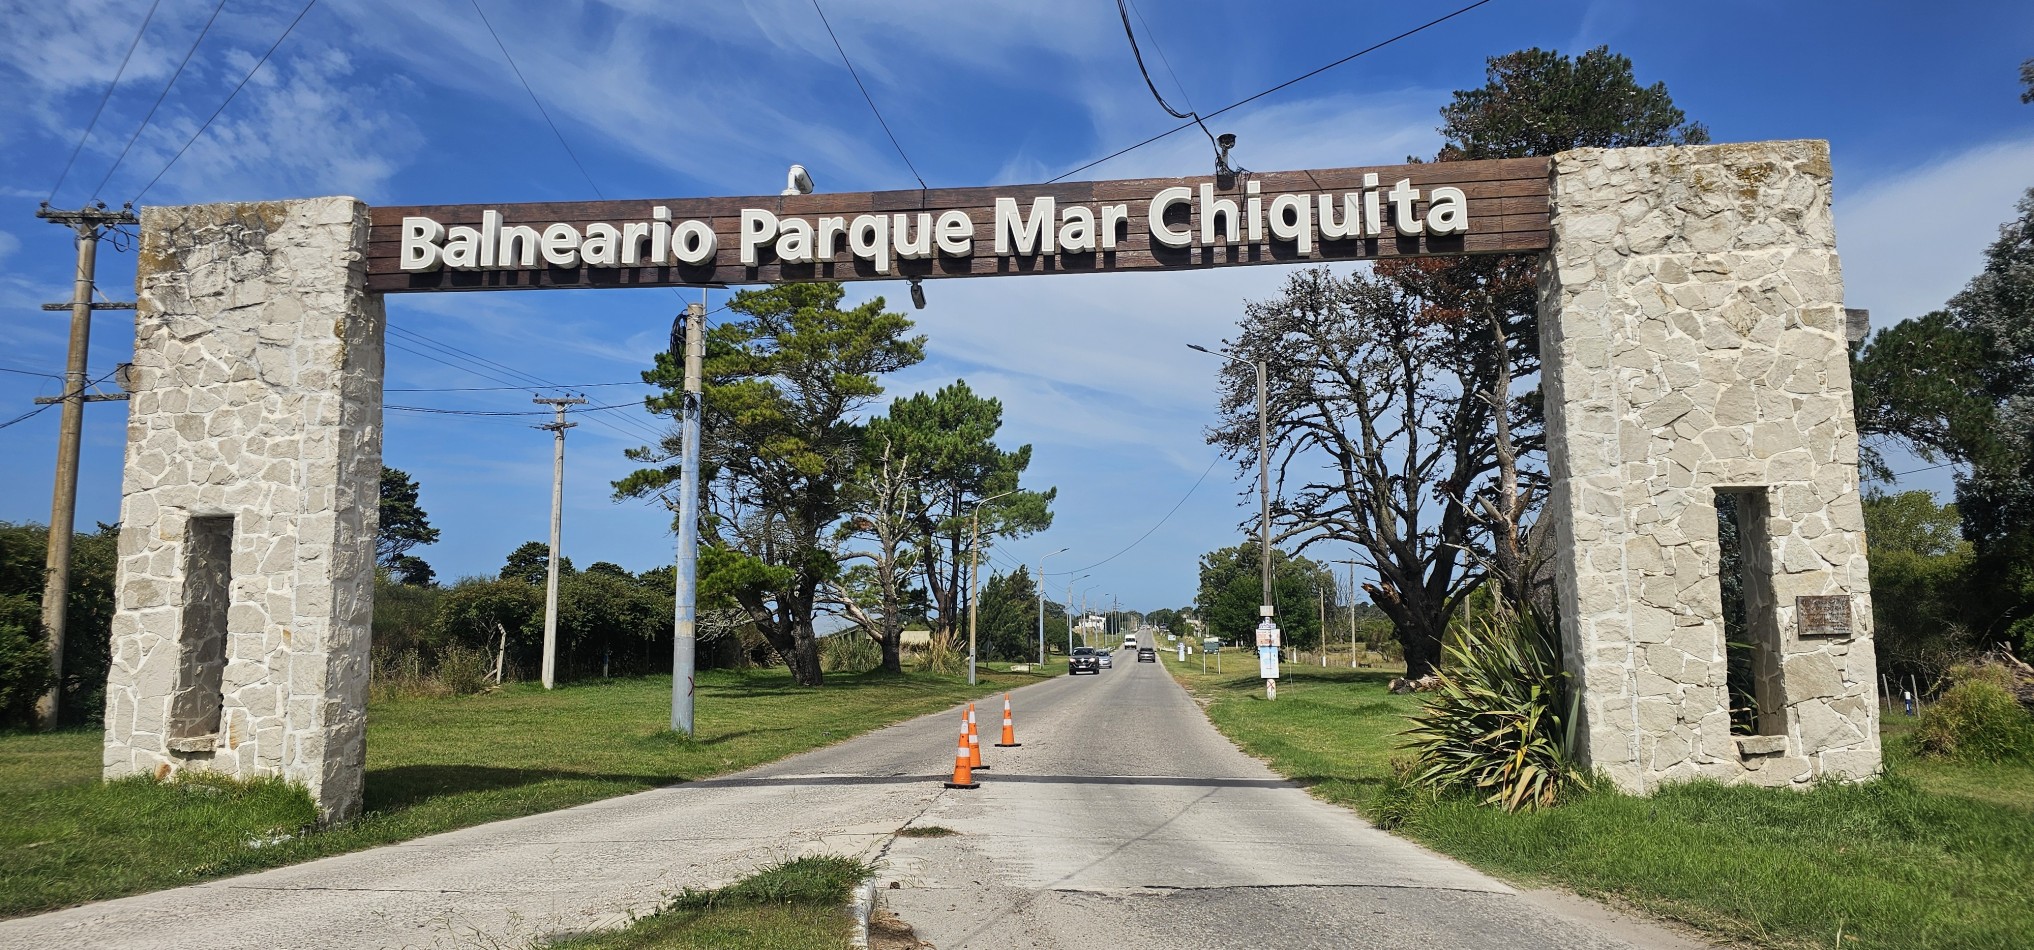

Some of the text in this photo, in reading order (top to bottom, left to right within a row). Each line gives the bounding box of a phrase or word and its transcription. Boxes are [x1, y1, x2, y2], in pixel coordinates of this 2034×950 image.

[401, 173, 1468, 274] Balneario Parque Mar Chiquita
